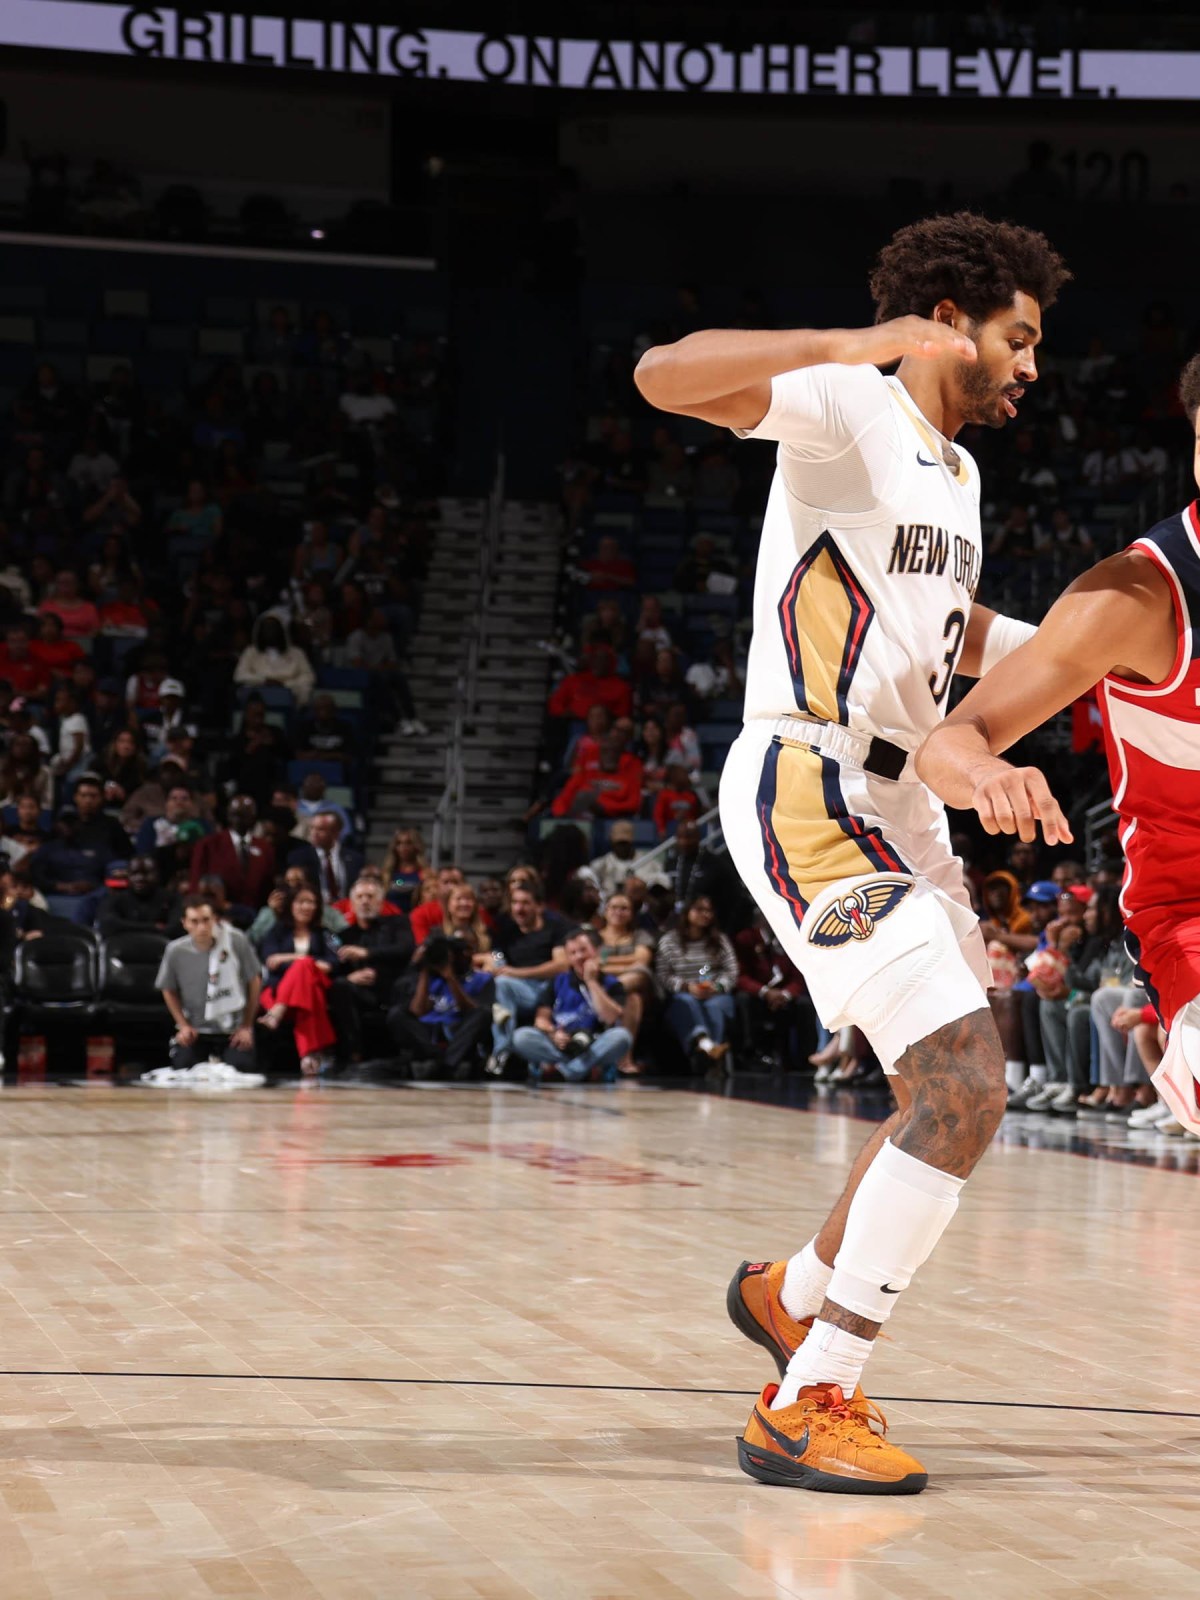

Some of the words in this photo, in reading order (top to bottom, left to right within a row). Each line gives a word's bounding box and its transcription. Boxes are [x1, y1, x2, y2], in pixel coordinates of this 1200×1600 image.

[122, 8, 448, 79] GRILLING.
[476, 32, 560, 86] ON
[583, 39, 883, 95] ANOTHER
[911, 47, 1117, 99] LEVEL.
[886, 523, 950, 577] NEW
[927, 606, 965, 706] 3
